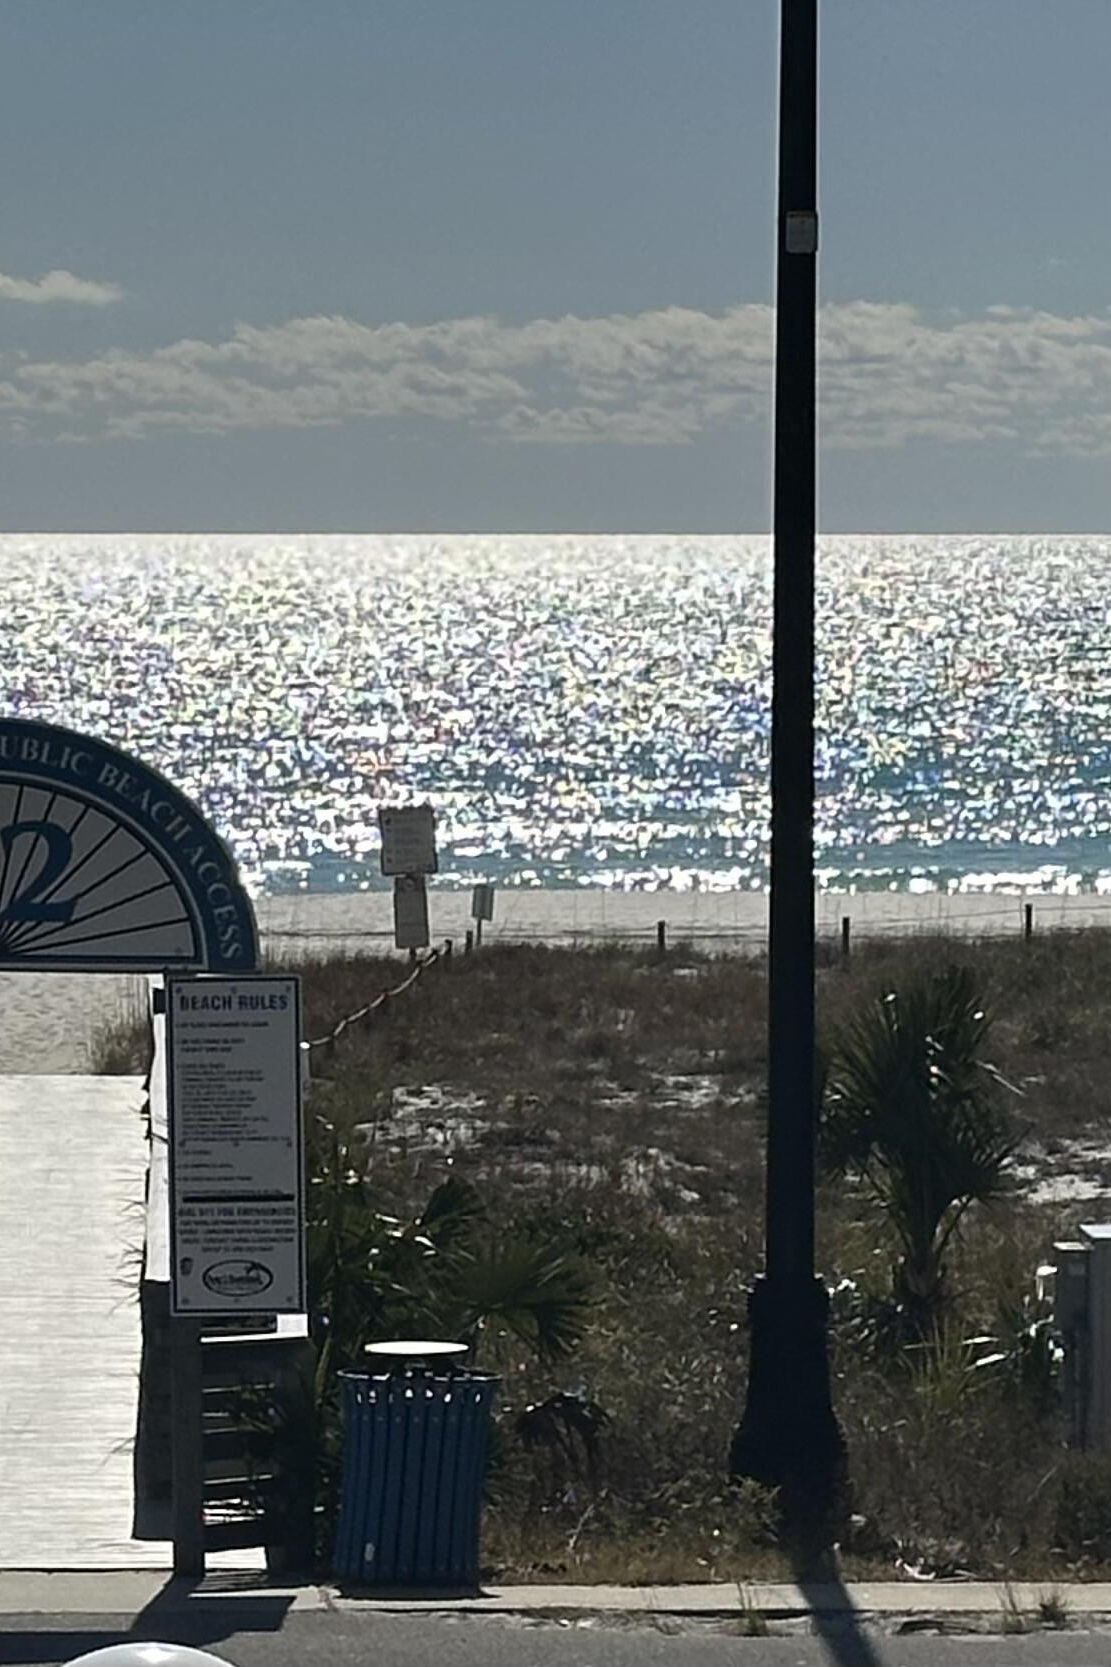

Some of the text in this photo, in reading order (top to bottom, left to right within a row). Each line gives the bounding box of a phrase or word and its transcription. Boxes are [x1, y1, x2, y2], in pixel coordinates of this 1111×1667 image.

[97, 762, 193, 841] BEACH
[184, 844, 242, 959] ACCESS
[180, 994, 288, 1011] BEACH RULES
